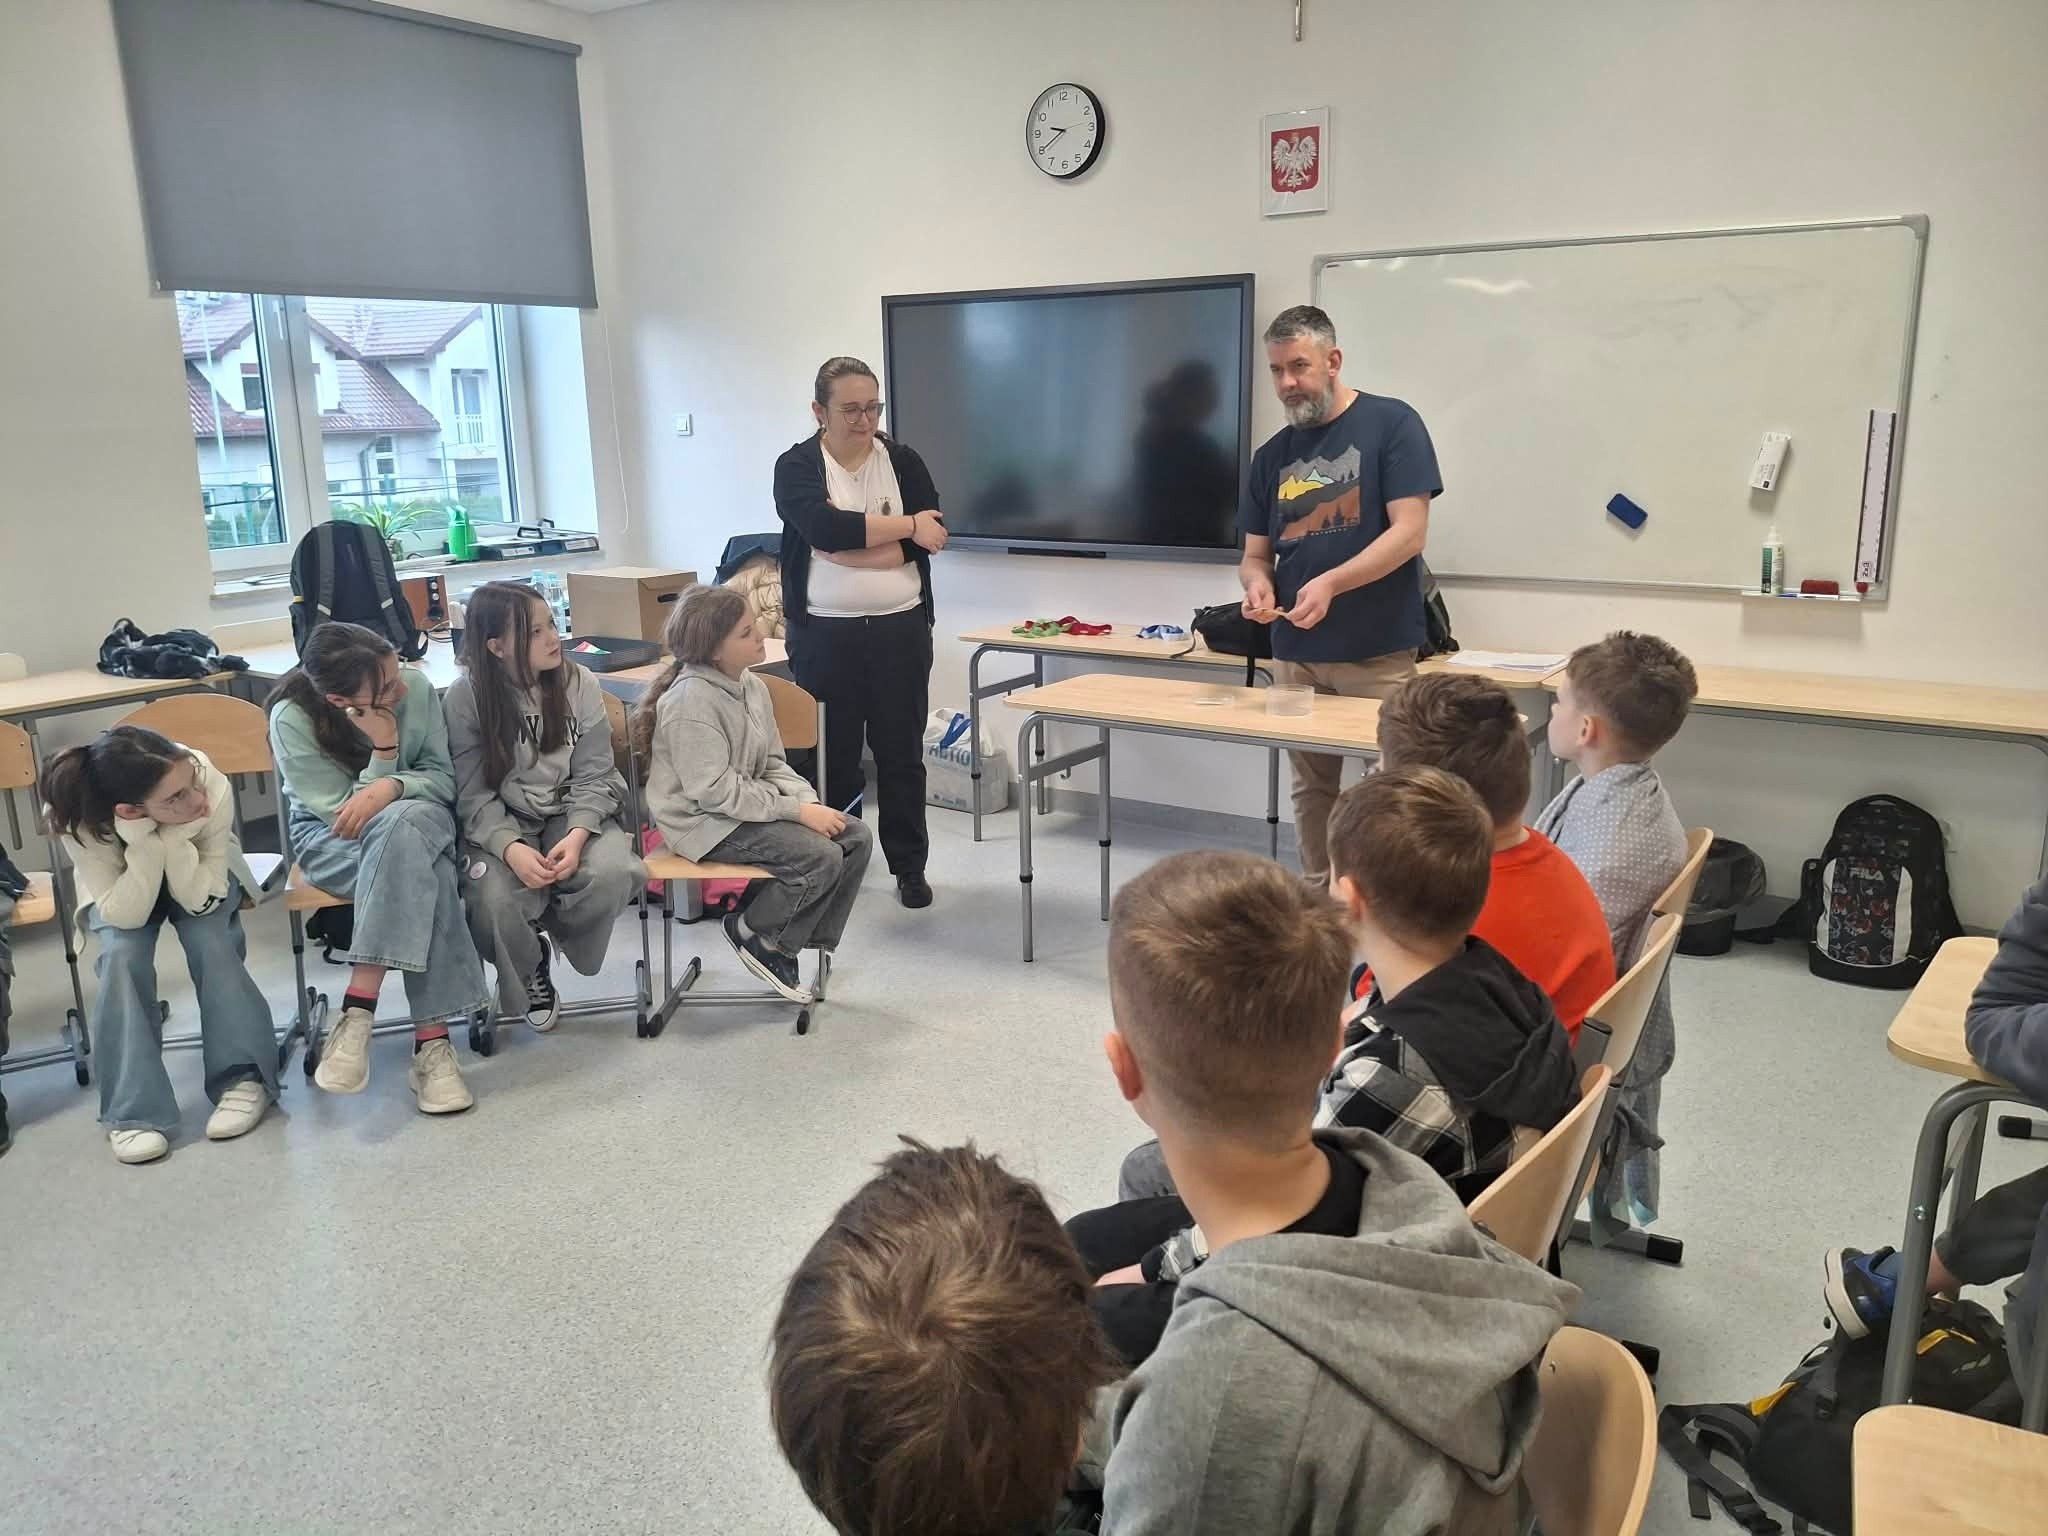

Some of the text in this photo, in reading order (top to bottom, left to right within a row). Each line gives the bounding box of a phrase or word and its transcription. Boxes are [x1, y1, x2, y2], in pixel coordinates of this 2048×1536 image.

[1059, 91, 1068, 101] 12
[1047, 98, 1054, 109] 11
[1083, 105, 1090, 115] 2
[1037, 112, 1047, 122] 10
[1088, 122, 1095, 131] 3
[1034, 129, 1041, 138] 9
[1083, 140, 1091, 149] 4
[1039, 146, 1045, 155] 8
[1048, 156, 1055, 167] 7
[1074, 153, 1082, 163] 5
[1061, 160, 1069, 169] 6
[1850, 867, 1884, 880] FILA
